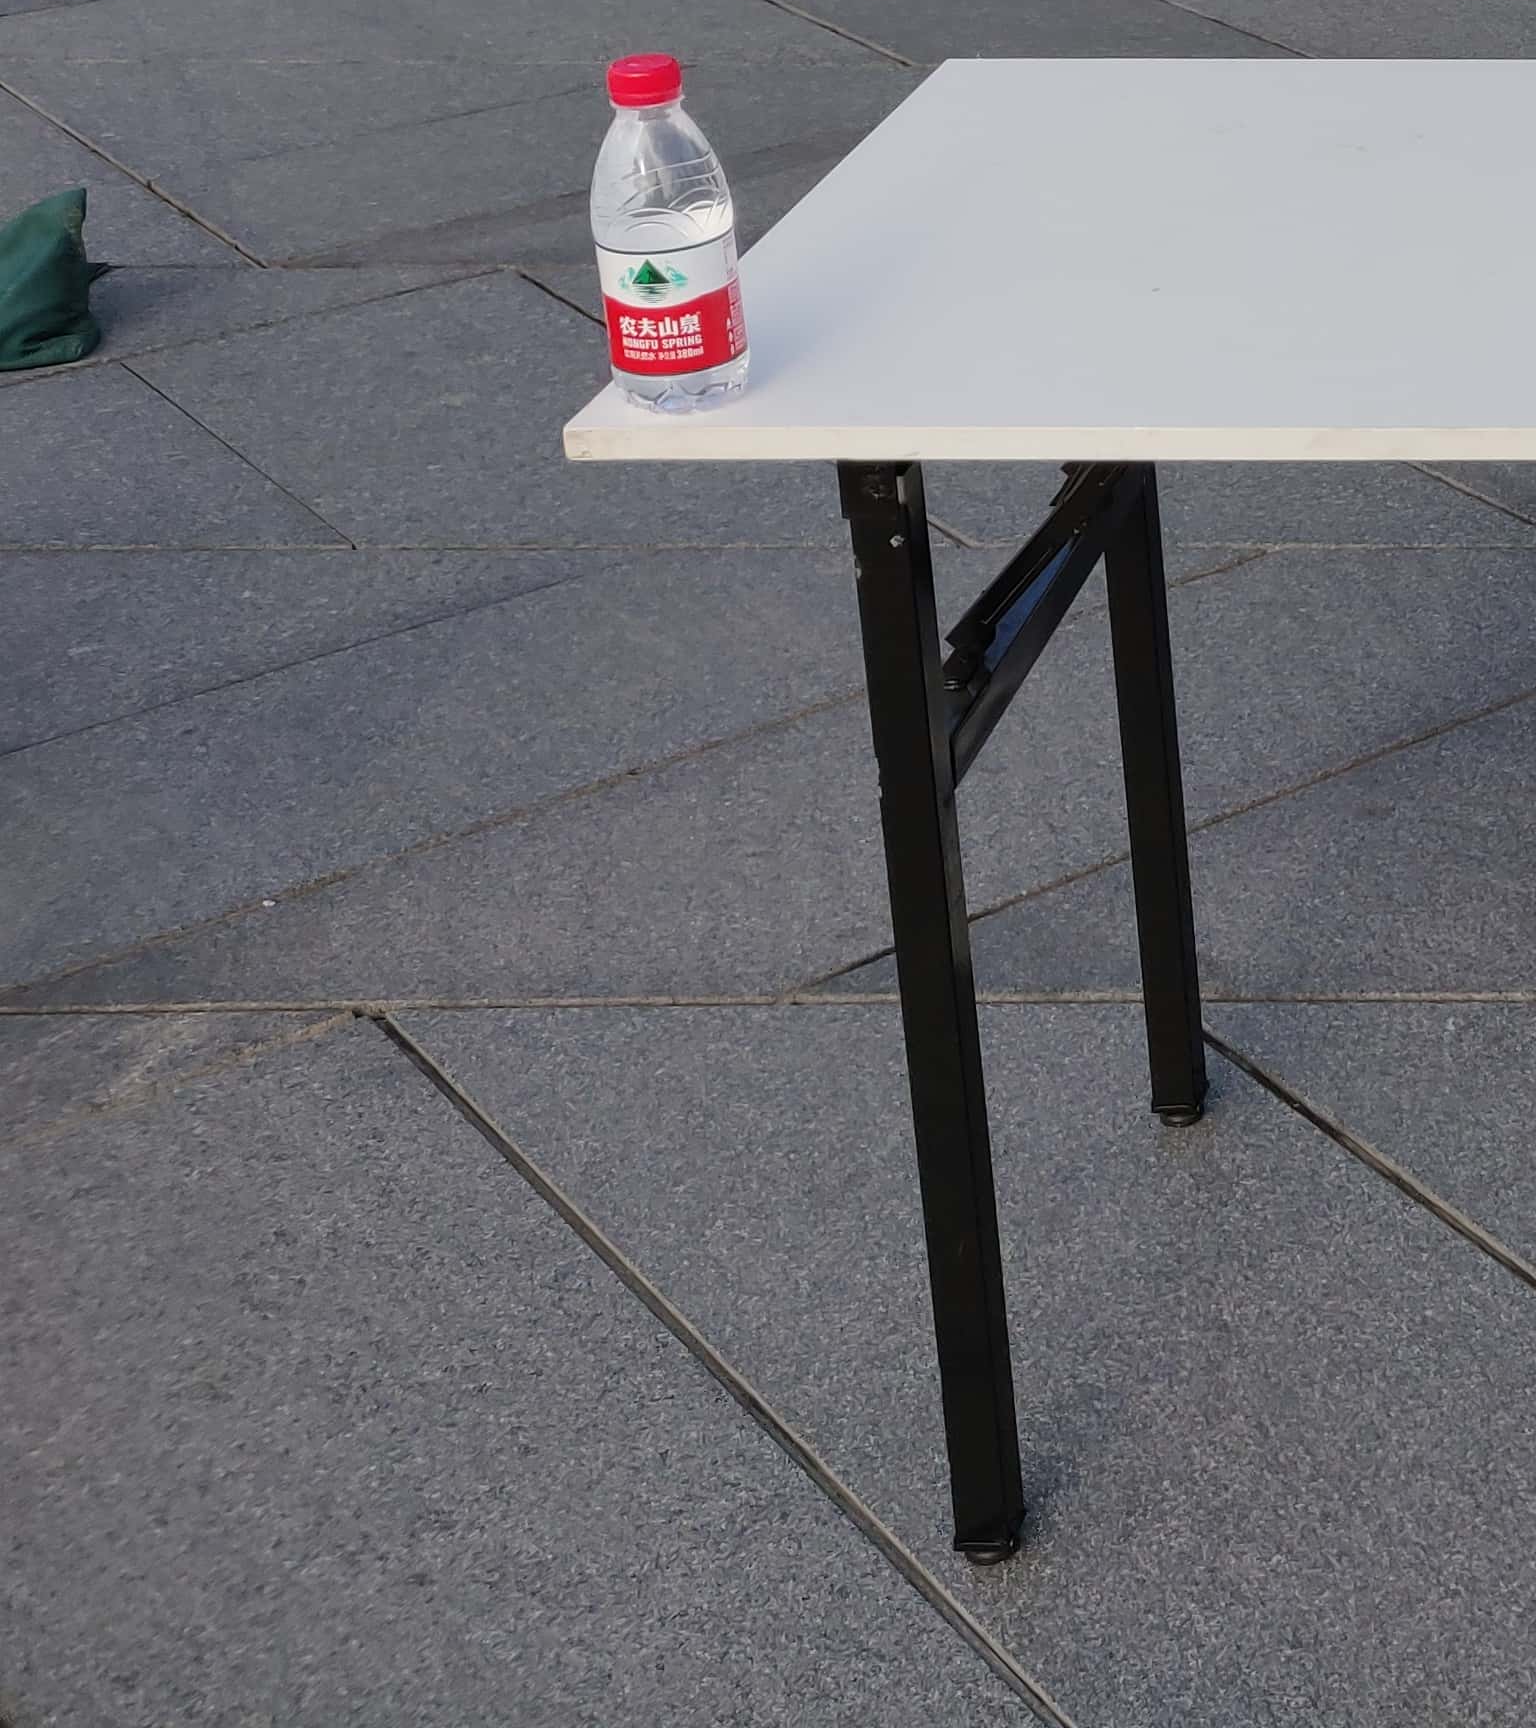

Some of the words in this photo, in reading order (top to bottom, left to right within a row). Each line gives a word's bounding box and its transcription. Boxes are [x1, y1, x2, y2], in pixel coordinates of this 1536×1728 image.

[619, 313, 700, 338] 农夫山泉
[662, 334, 702, 349] SPRING
